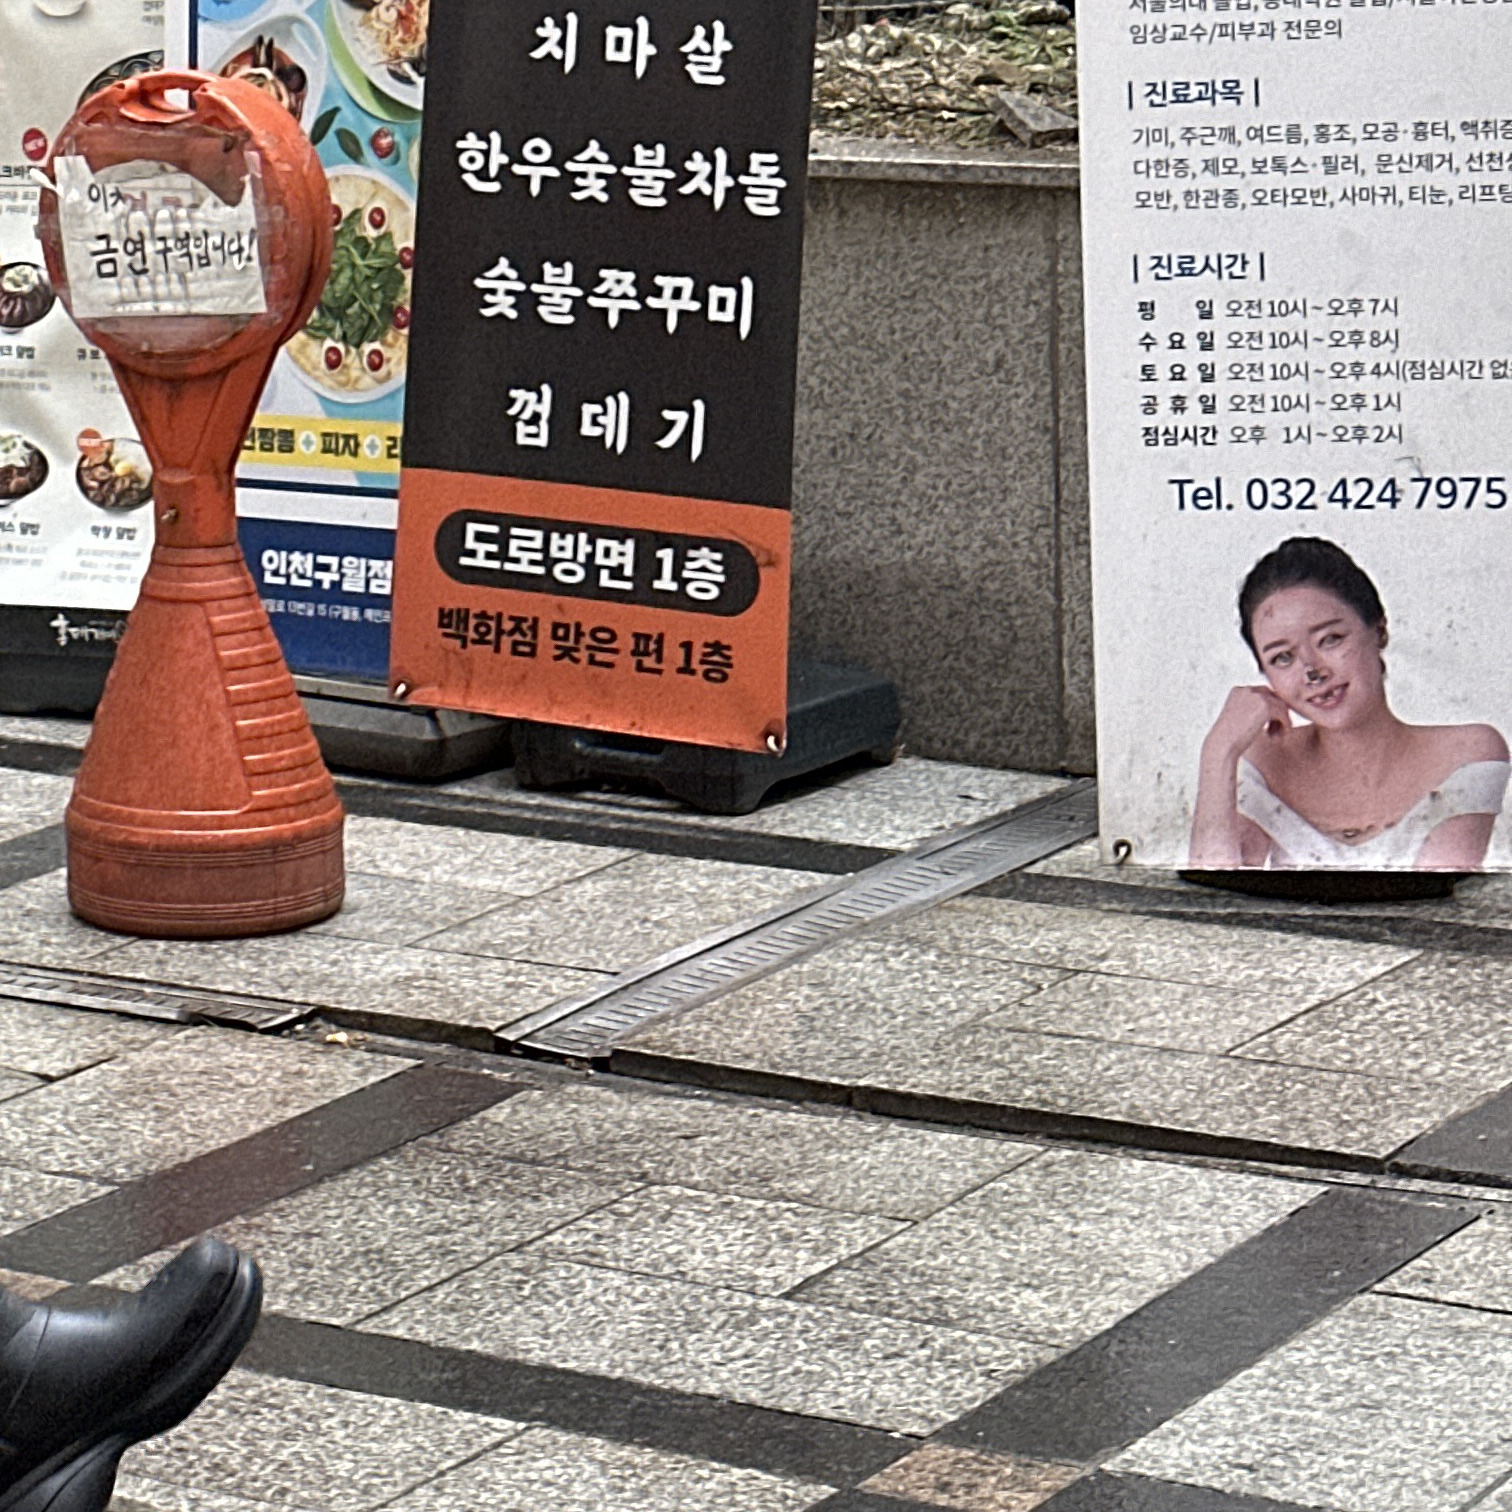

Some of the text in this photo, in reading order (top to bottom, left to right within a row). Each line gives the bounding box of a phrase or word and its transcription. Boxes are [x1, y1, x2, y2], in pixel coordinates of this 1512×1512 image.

[1129, 18, 1342, 45] 임상교수/피부과 전문의
[1144, 80, 1244, 108] 진료과목
[1133, 126, 1176, 148] 기미,
[1180, 125, 1242, 148] 주근깨,
[1246, 124, 1309, 147] 여드름,
[1313, 123, 1357, 146] 홍조,
[455, 131, 788, 216] 한우숯불차돌
[1133, 157, 1197, 180] 다한증,
[1201, 156, 1247, 180] 제모,
[1375, 153, 1461, 175] 문신제거,
[1135, 188, 1178, 212] 모반,
[1182, 187, 1247, 210] 한관종,
[1251, 186, 1335, 209] 오타모반,
[1338, 185, 1404, 208] 사마귀,
[1408, 184, 1454, 207] 티눈,
[1149, 254, 1249, 281] 진료시간
[473, 256, 754, 341] 숯불쭈꾸미
[1225, 297, 1263, 319] 오전
[1369, 296, 1398, 318] 7시
[1226, 330, 1264, 350] 오전
[1369, 328, 1399, 350] 8시
[1227, 362, 1265, 383] 오전
[1229, 394, 1266, 414] 오전
[1373, 392, 1402, 414] 1시
[320, 432, 360, 458] 피자
[1141, 425, 1218, 447] 점심시간
[1230, 425, 1266, 445] 오후
[1374, 424, 1403, 445] 2시
[1169, 476, 1507, 511] Tel. 032 424 7975
[262, 550, 393, 595] 인천구월점
[458, 521, 727, 601] 도로방면 1층
[437, 607, 735, 684] 백화점 맞은 편 1층
